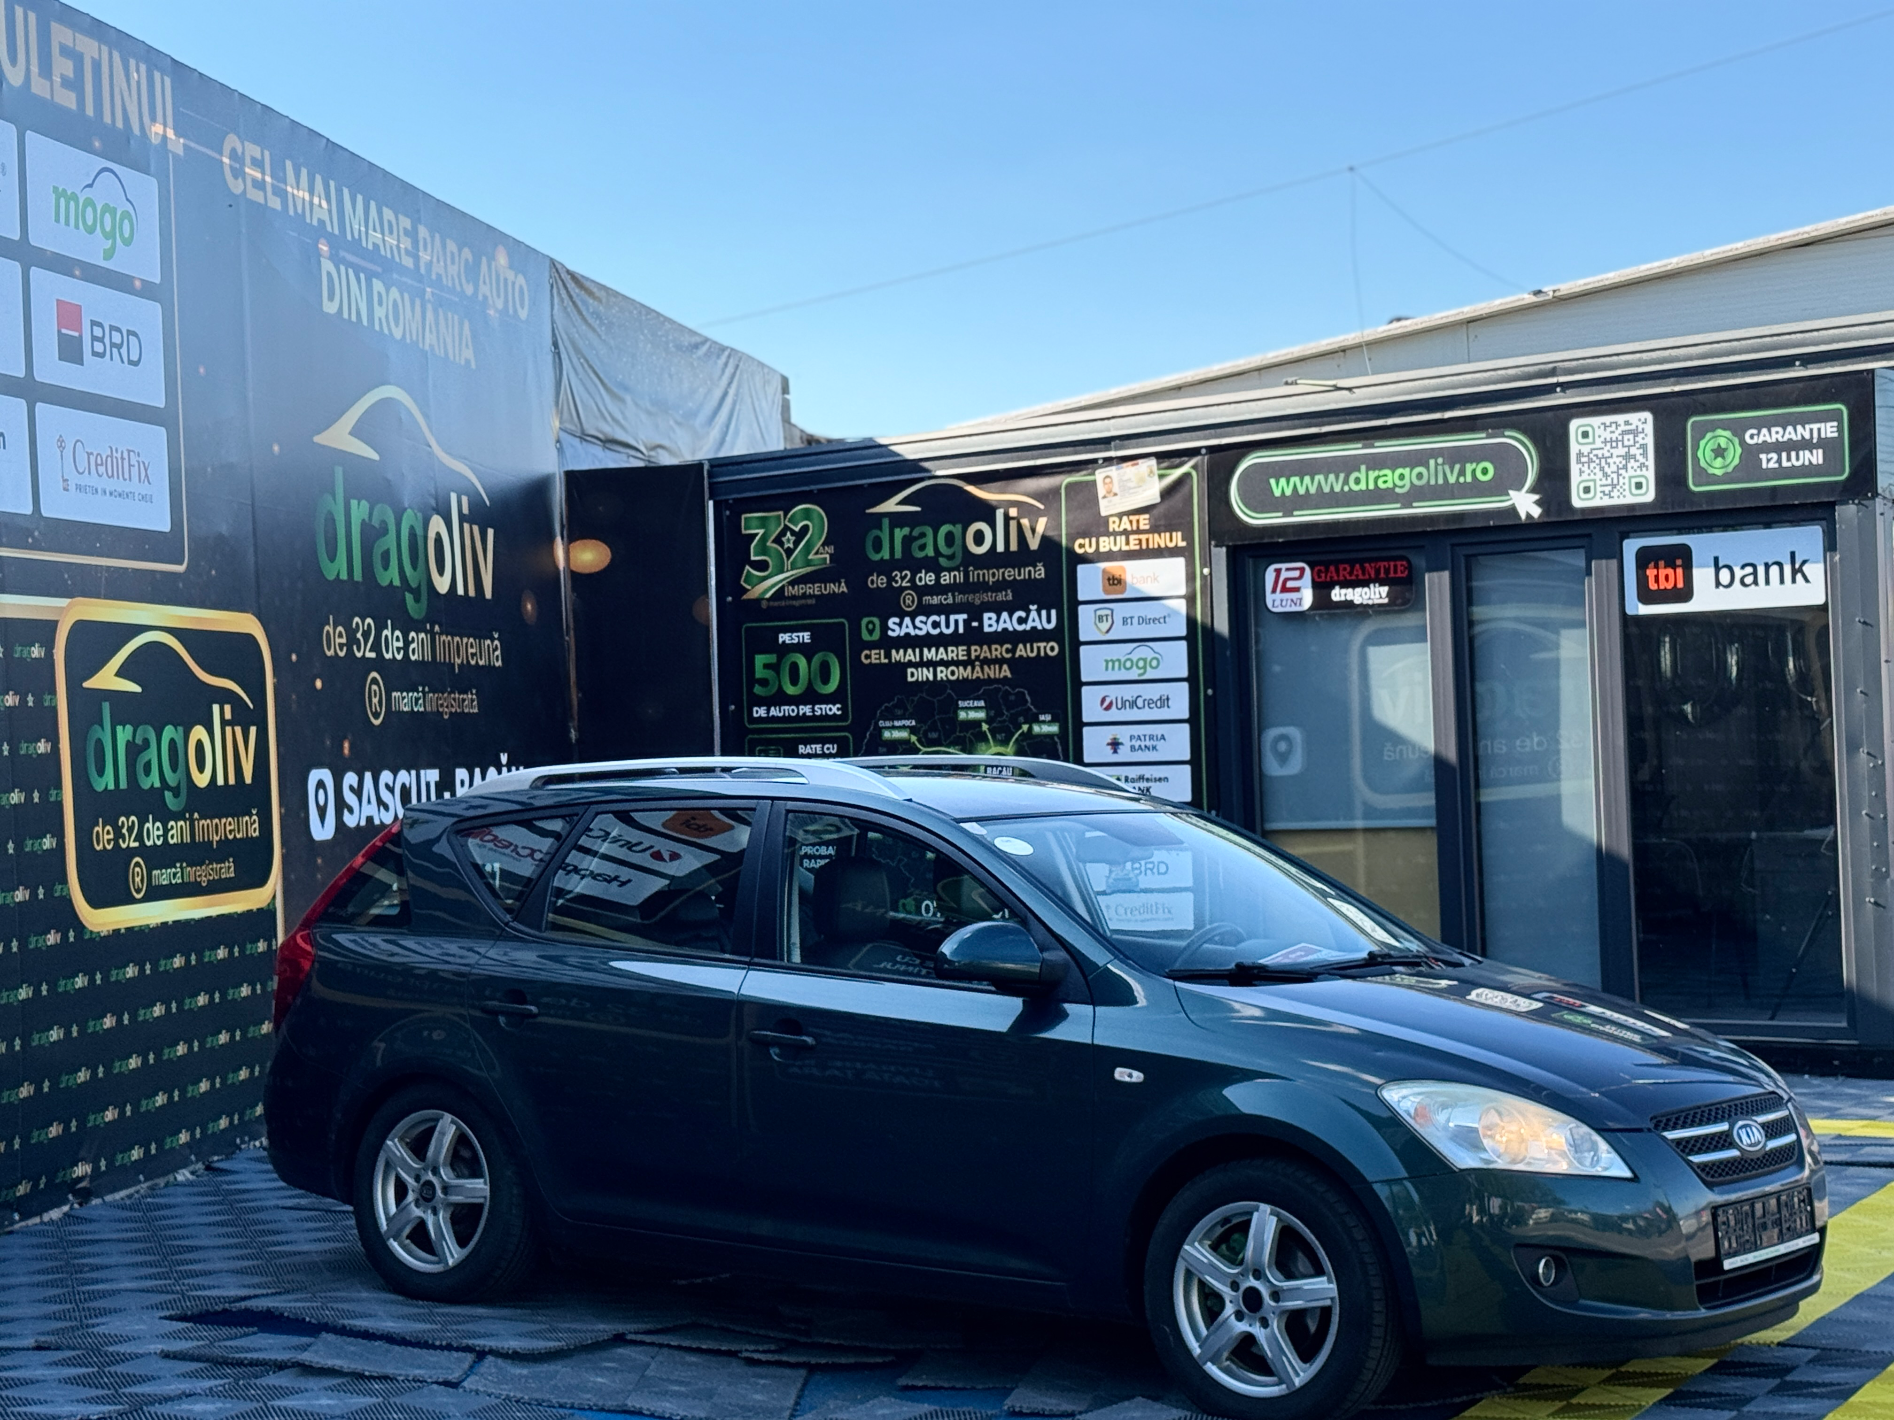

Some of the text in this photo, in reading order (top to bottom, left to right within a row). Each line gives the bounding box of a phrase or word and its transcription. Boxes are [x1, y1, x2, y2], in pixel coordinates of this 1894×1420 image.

[52, 185, 135, 261] mogo
[222, 133, 529, 321] CEL MAI MARE PARC AUTO
[320, 257, 476, 369] DIN ROMÂNIA
[90, 319, 143, 367] BRD
[72, 439, 152, 485] CreditFix
[1759, 448, 1824, 469] 12 LUNI
[1269, 457, 1495, 498] www.dragoliv.ro
[75, 483, 98, 495] PRIETEN
[1108, 514, 1150, 532] RATE
[316, 466, 494, 620] dragoliv
[740, 503, 829, 589] 32
[865, 507, 1048, 568] dragoliv
[1074, 531, 1187, 554] CU BULETINUL
[868, 562, 1046, 588] de 32 de ani împreună
[1106, 572, 1160, 587] tbi bank
[1270, 566, 1306, 594] 12
[1313, 561, 1409, 582] GARANTIE
[1646, 550, 1812, 590] tbi bank
[784, 579, 848, 598] ÎMPREUNĂ
[922, 592, 953, 605] marcă
[955, 589, 1013, 605] înregistrată
[1331, 583, 1389, 605] dragoliv
[1271, 597, 1303, 609] LUNI
[887, 614, 968, 637] SASCUT
[983, 604, 1057, 632] BACĂU
[1097, 613, 1111, 624] BT
[1122, 616, 1135, 626] BT
[322, 615, 502, 673] de 32 de ani împreună
[778, 631, 811, 644] PESTE
[861, 641, 1059, 664] CEL MAI MARE PARC AUTO
[753, 651, 840, 697] 500
[907, 662, 1012, 682] DIN ROMÂNIA
[1104, 656, 1160, 677] mogo
[391, 686, 424, 712] marcă
[425, 686, 479, 719] înregistrată
[753, 704, 842, 717] DE AUTO PE STOC
[1115, 694, 1171, 711] UniCredit
[798, 743, 837, 754] RATE CU
[1129, 733, 1166, 743] PATRIA
[1129, 744, 1159, 753] BANK
[86, 701, 257, 812] dragoliv
[1124, 774, 1169, 784] Raiffeisen
[92, 808, 260, 851] de 32 de ani împreună
[151, 862, 183, 886] marcă
[183, 857, 235, 887] înregistrată
[1131, 860, 1169, 877] BRD
[1739, 1125, 1762, 1145] KIA
